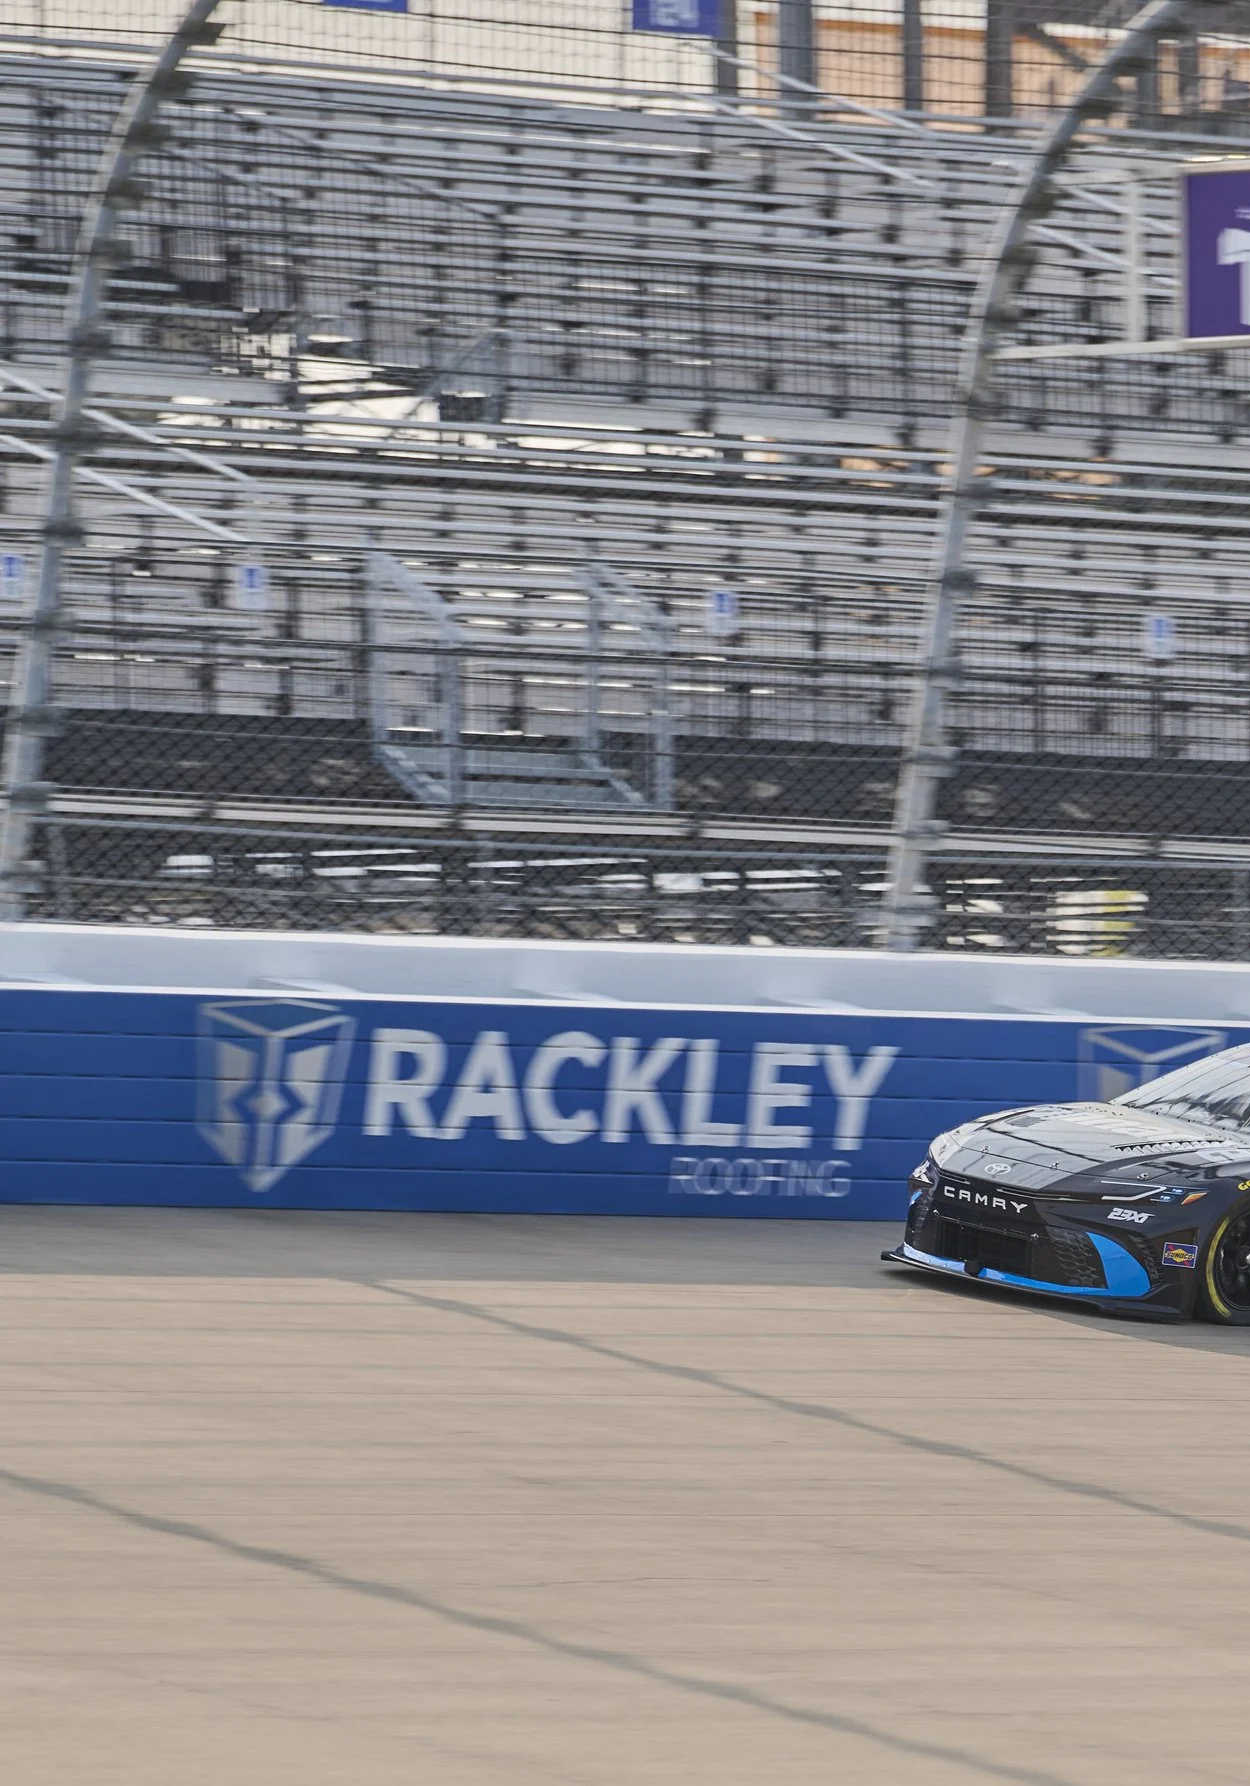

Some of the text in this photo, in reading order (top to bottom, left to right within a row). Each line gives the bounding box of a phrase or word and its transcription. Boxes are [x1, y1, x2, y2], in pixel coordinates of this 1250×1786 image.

[362, 1027, 901, 1151] RACKLEY
[668, 1156, 852, 1198] ROOFING
[943, 1185, 1028, 1214] CAMRY
[1164, 1250, 1195, 1261] SUNOCO
